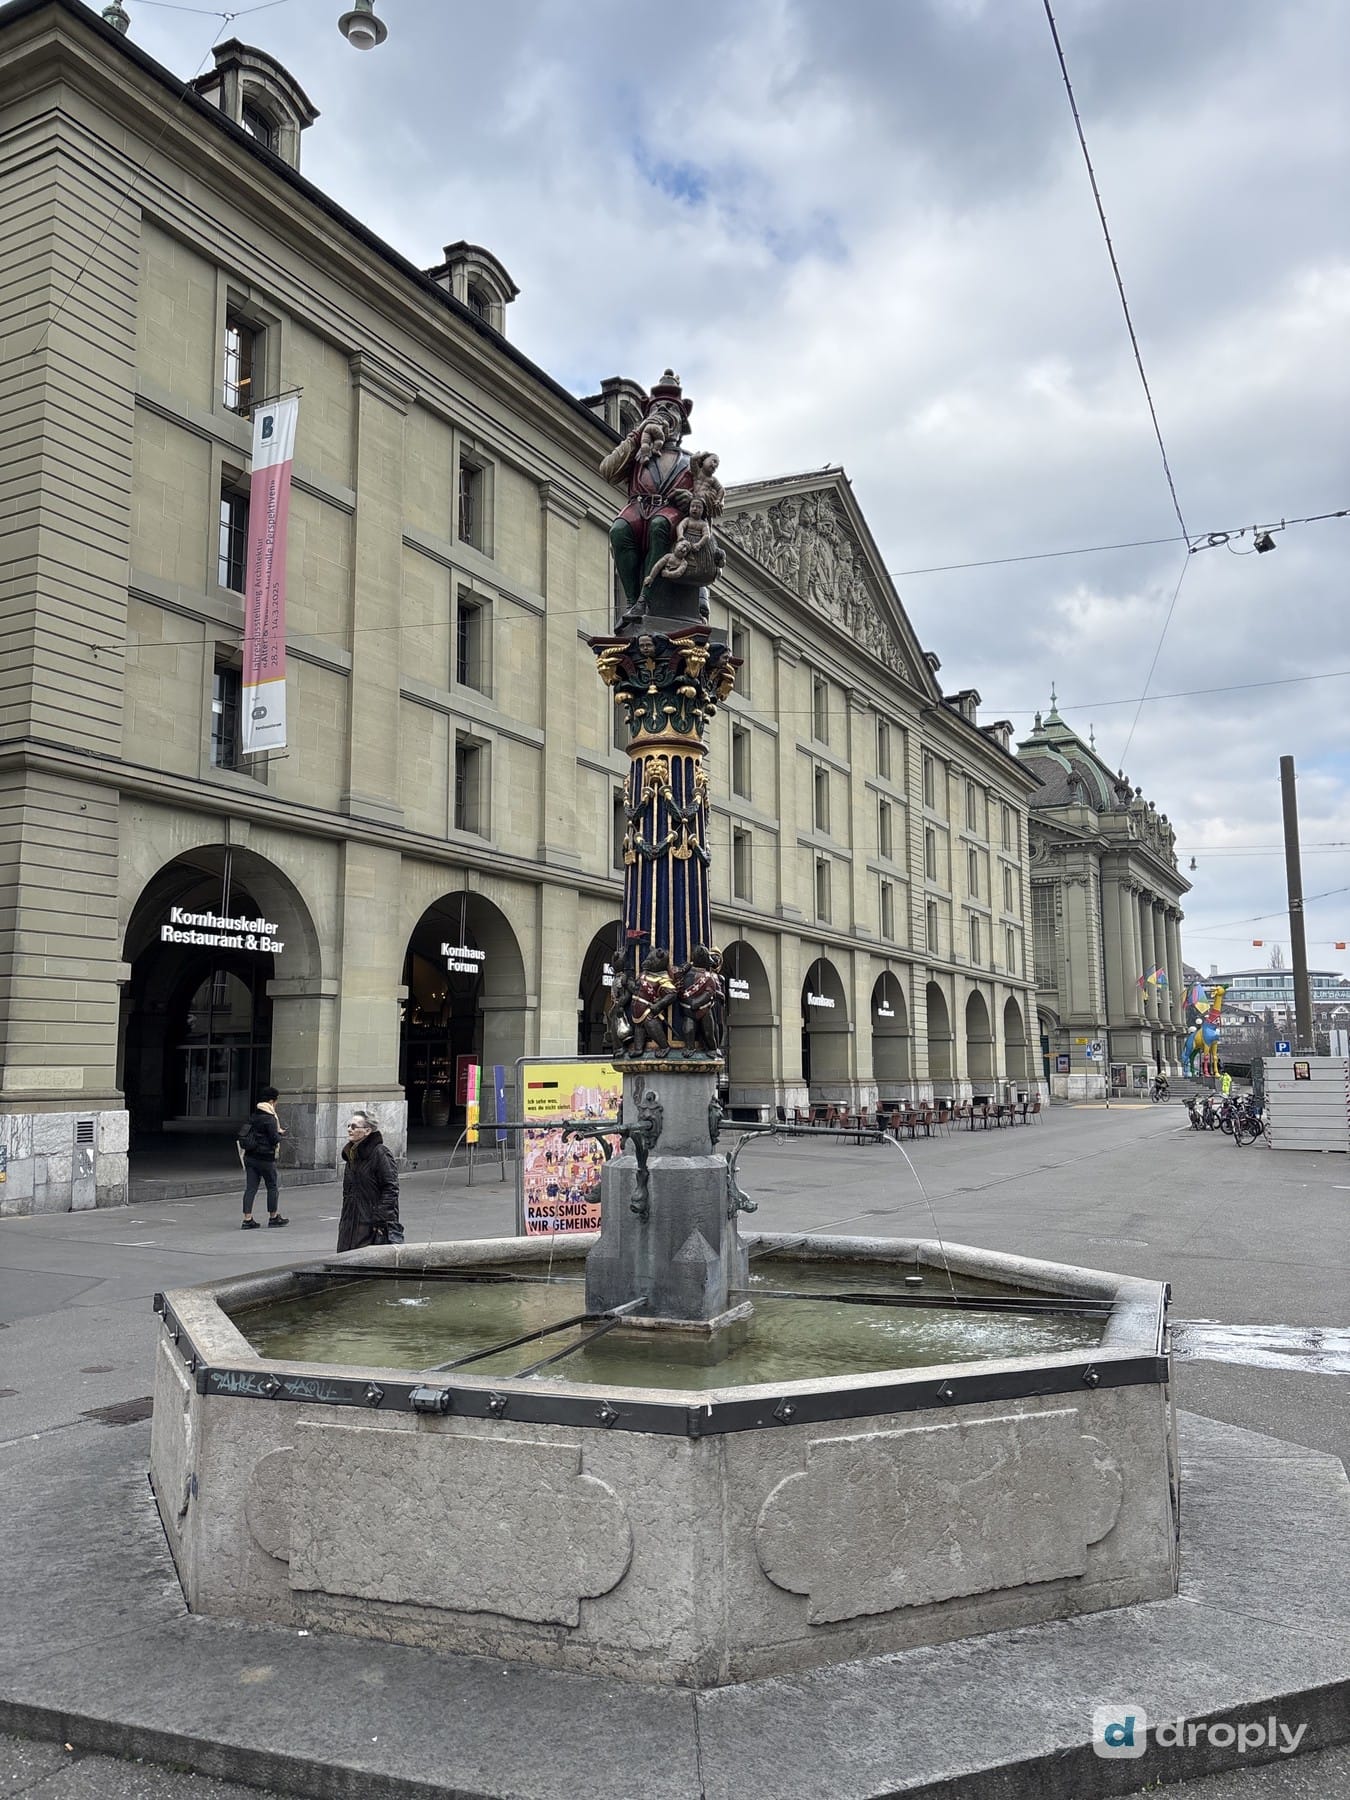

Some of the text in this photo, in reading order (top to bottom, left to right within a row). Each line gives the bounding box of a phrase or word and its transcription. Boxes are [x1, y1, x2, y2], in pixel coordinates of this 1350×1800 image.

[262, 415, 274, 440] B
[266, 479, 276, 545] Perspektiven»
[255, 538, 263, 588] Architektur
[272, 582, 280, 630] 14.3.2025
[170, 906, 279, 935] Kornhauskeller
[161, 925, 284, 954] Restaurant & Bar
[441, 942, 486, 961] Kornhaus
[447, 958, 479, 974] Forum
[1278, 1043, 1287, 1052] P
[528, 1220, 549, 1232] WIR
